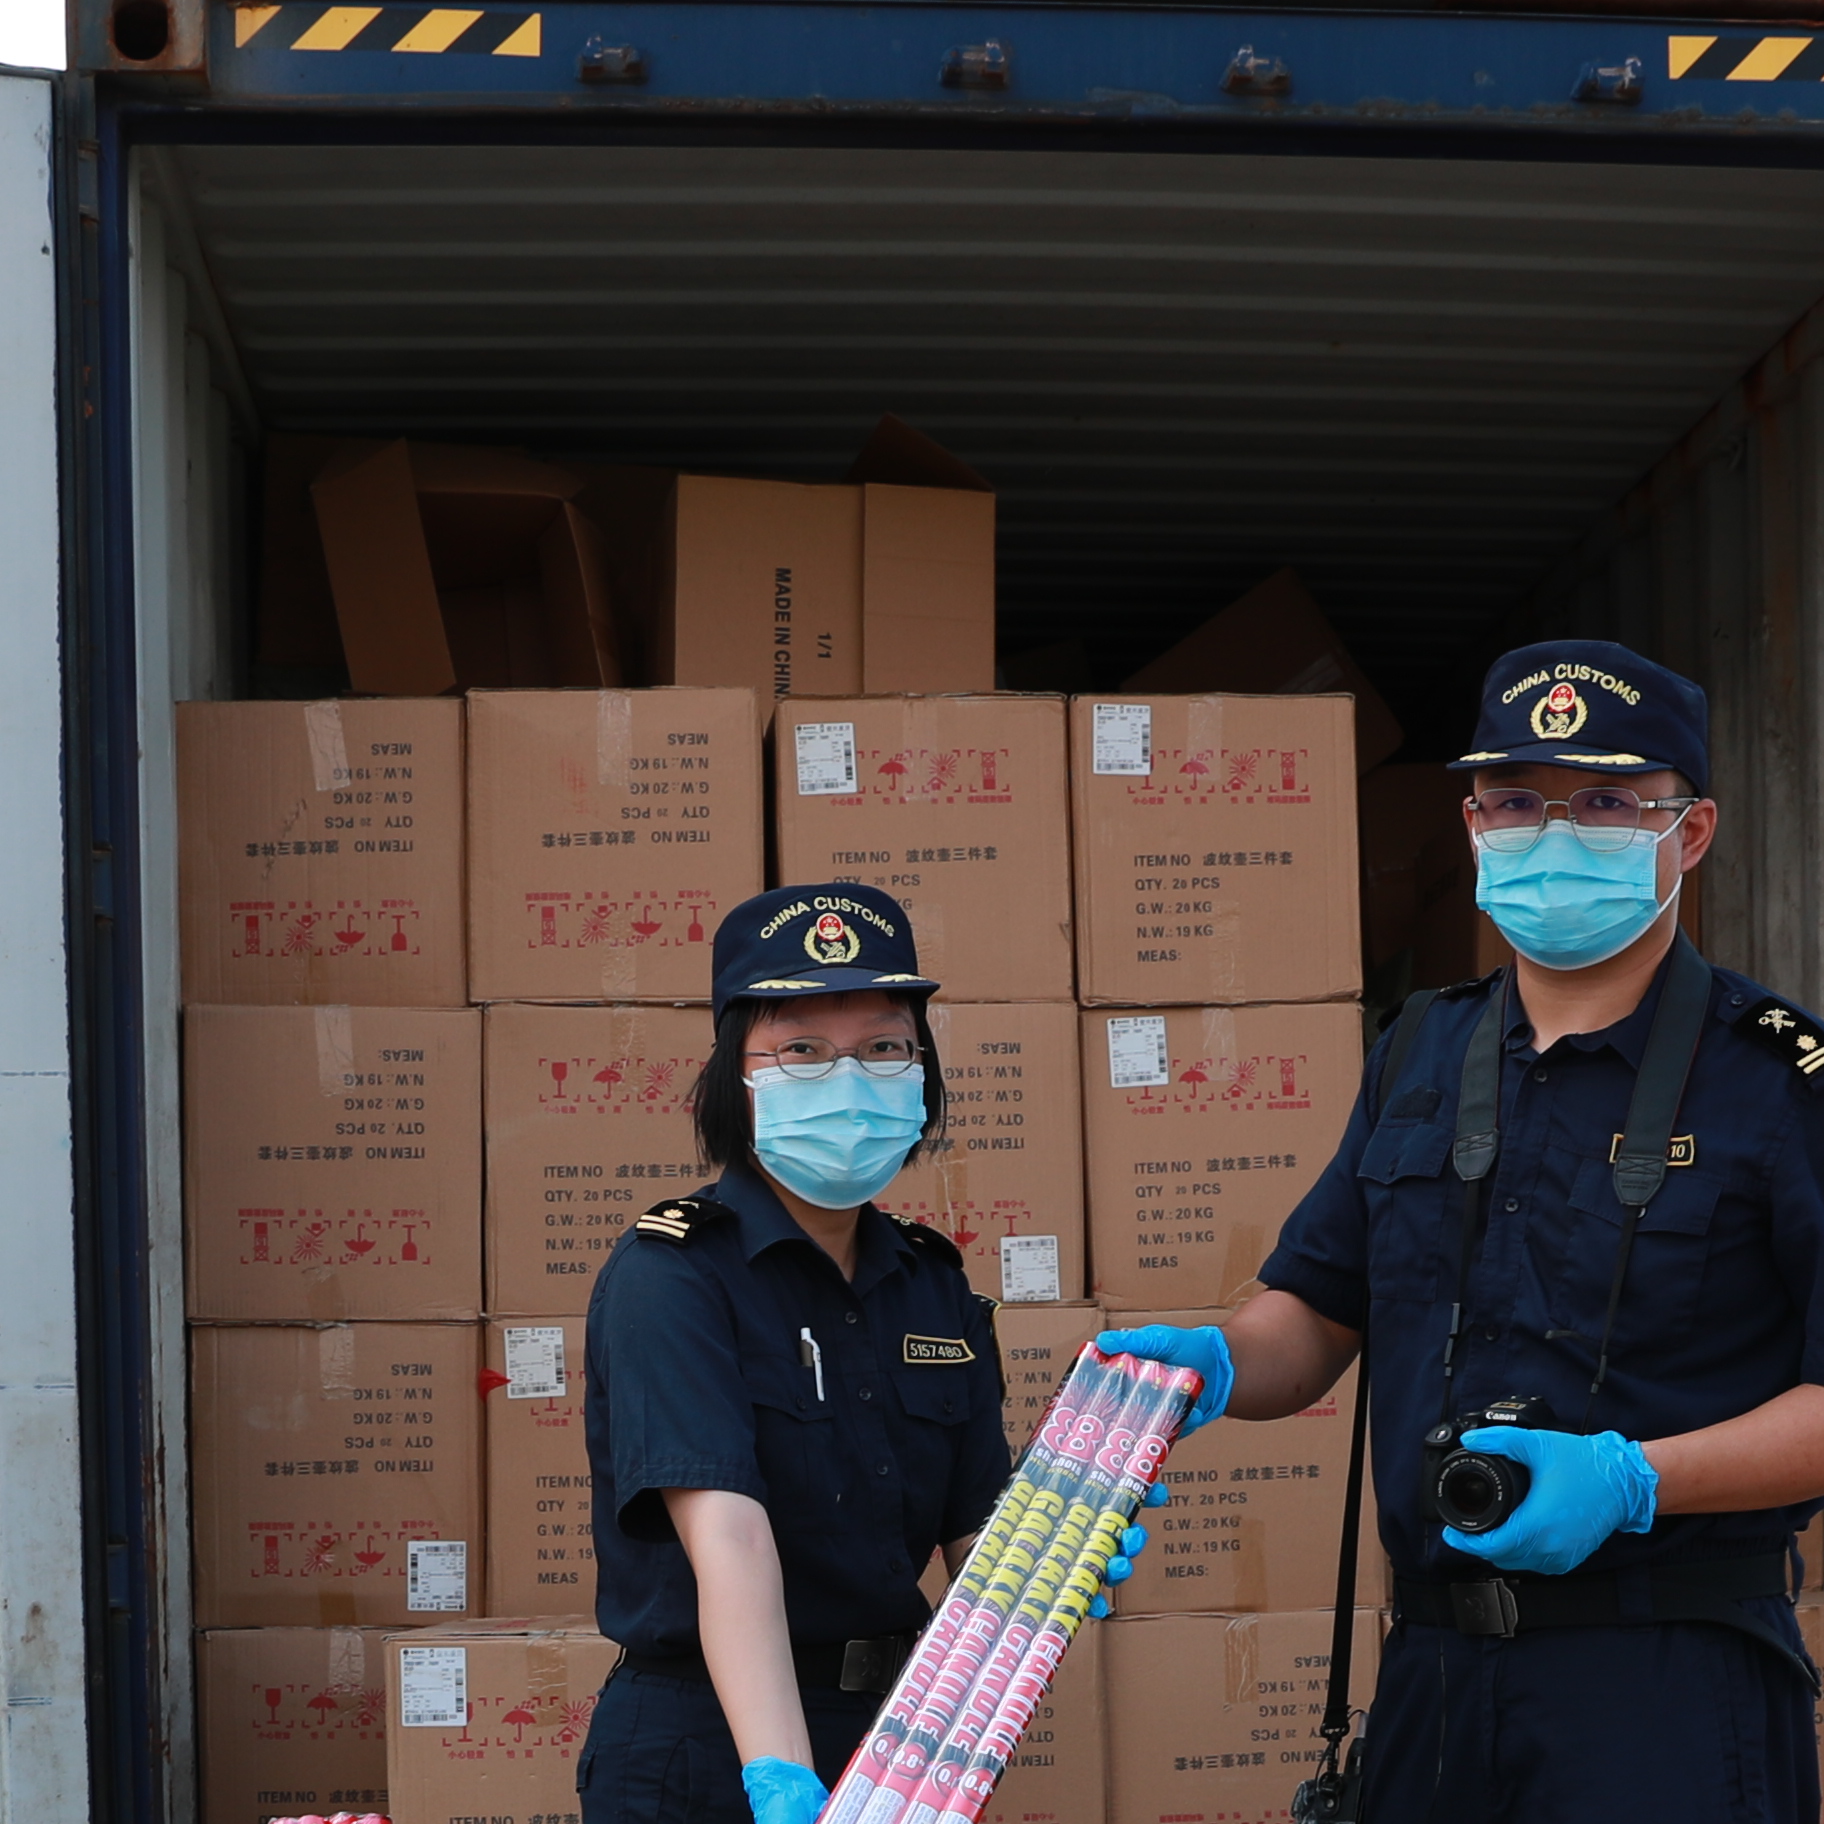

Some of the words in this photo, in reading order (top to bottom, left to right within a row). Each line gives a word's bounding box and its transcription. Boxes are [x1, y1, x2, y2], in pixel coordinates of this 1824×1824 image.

[775, 567, 791, 623] MADE
[775, 627, 791, 645] IN
[817, 632, 832, 659] 1/1
[774, 650, 790, 699] CHIN
[1502, 669, 1551, 705] CHINA
[1554, 663, 1642, 706] CUSTOMS
[371, 743, 413, 755] MEAS
[333, 768, 351, 780] KG
[357, 768, 371, 780] 19
[333, 791, 352, 804] KG
[357, 792, 371, 804] 20
[324, 816, 354, 828] PCS
[384, 816, 413, 829] QTY
[354, 840, 375, 853] NO
[379, 840, 413, 853] ITEM
[1134, 854, 1167, 867] ITEM
[1170, 854, 1191, 867] NO
[1172, 878, 1187, 890] 20
[1191, 877, 1220, 890] PCS
[1175, 902, 1191, 914] 20
[1193, 901, 1212, 914] KG
[760, 901, 811, 940] CHINA
[813, 896, 896, 938] CUSTOMS
[1175, 926, 1190, 938] 19
[1194, 925, 1213, 937] KG
[1137, 950, 1182, 963] MEAS:
[1134, 1161, 1168, 1175] ITEM
[1171, 1160, 1192, 1173] NO
[1135, 1185, 1163, 1198] QTY
[1192, 1183, 1222, 1196] PCS
[1175, 1208, 1191, 1220] 20
[1194, 1207, 1214, 1219] KG
[1177, 1232, 1192, 1244] 19
[1195, 1230, 1215, 1243] KG
[1138, 1256, 1178, 1269] MEAS
[909, 1342, 963, 1358] 5157480
[1123, 1434, 1171, 1486] 8
[1161, 1471, 1194, 1485] ITEM
[1197, 1469, 1218, 1482] NO
[1203, 1541, 1218, 1553] 19
[1220, 1539, 1241, 1552] KG
[1165, 1564, 1210, 1578] MEAS:
[975, 1629, 1068, 1767] CANDLE
